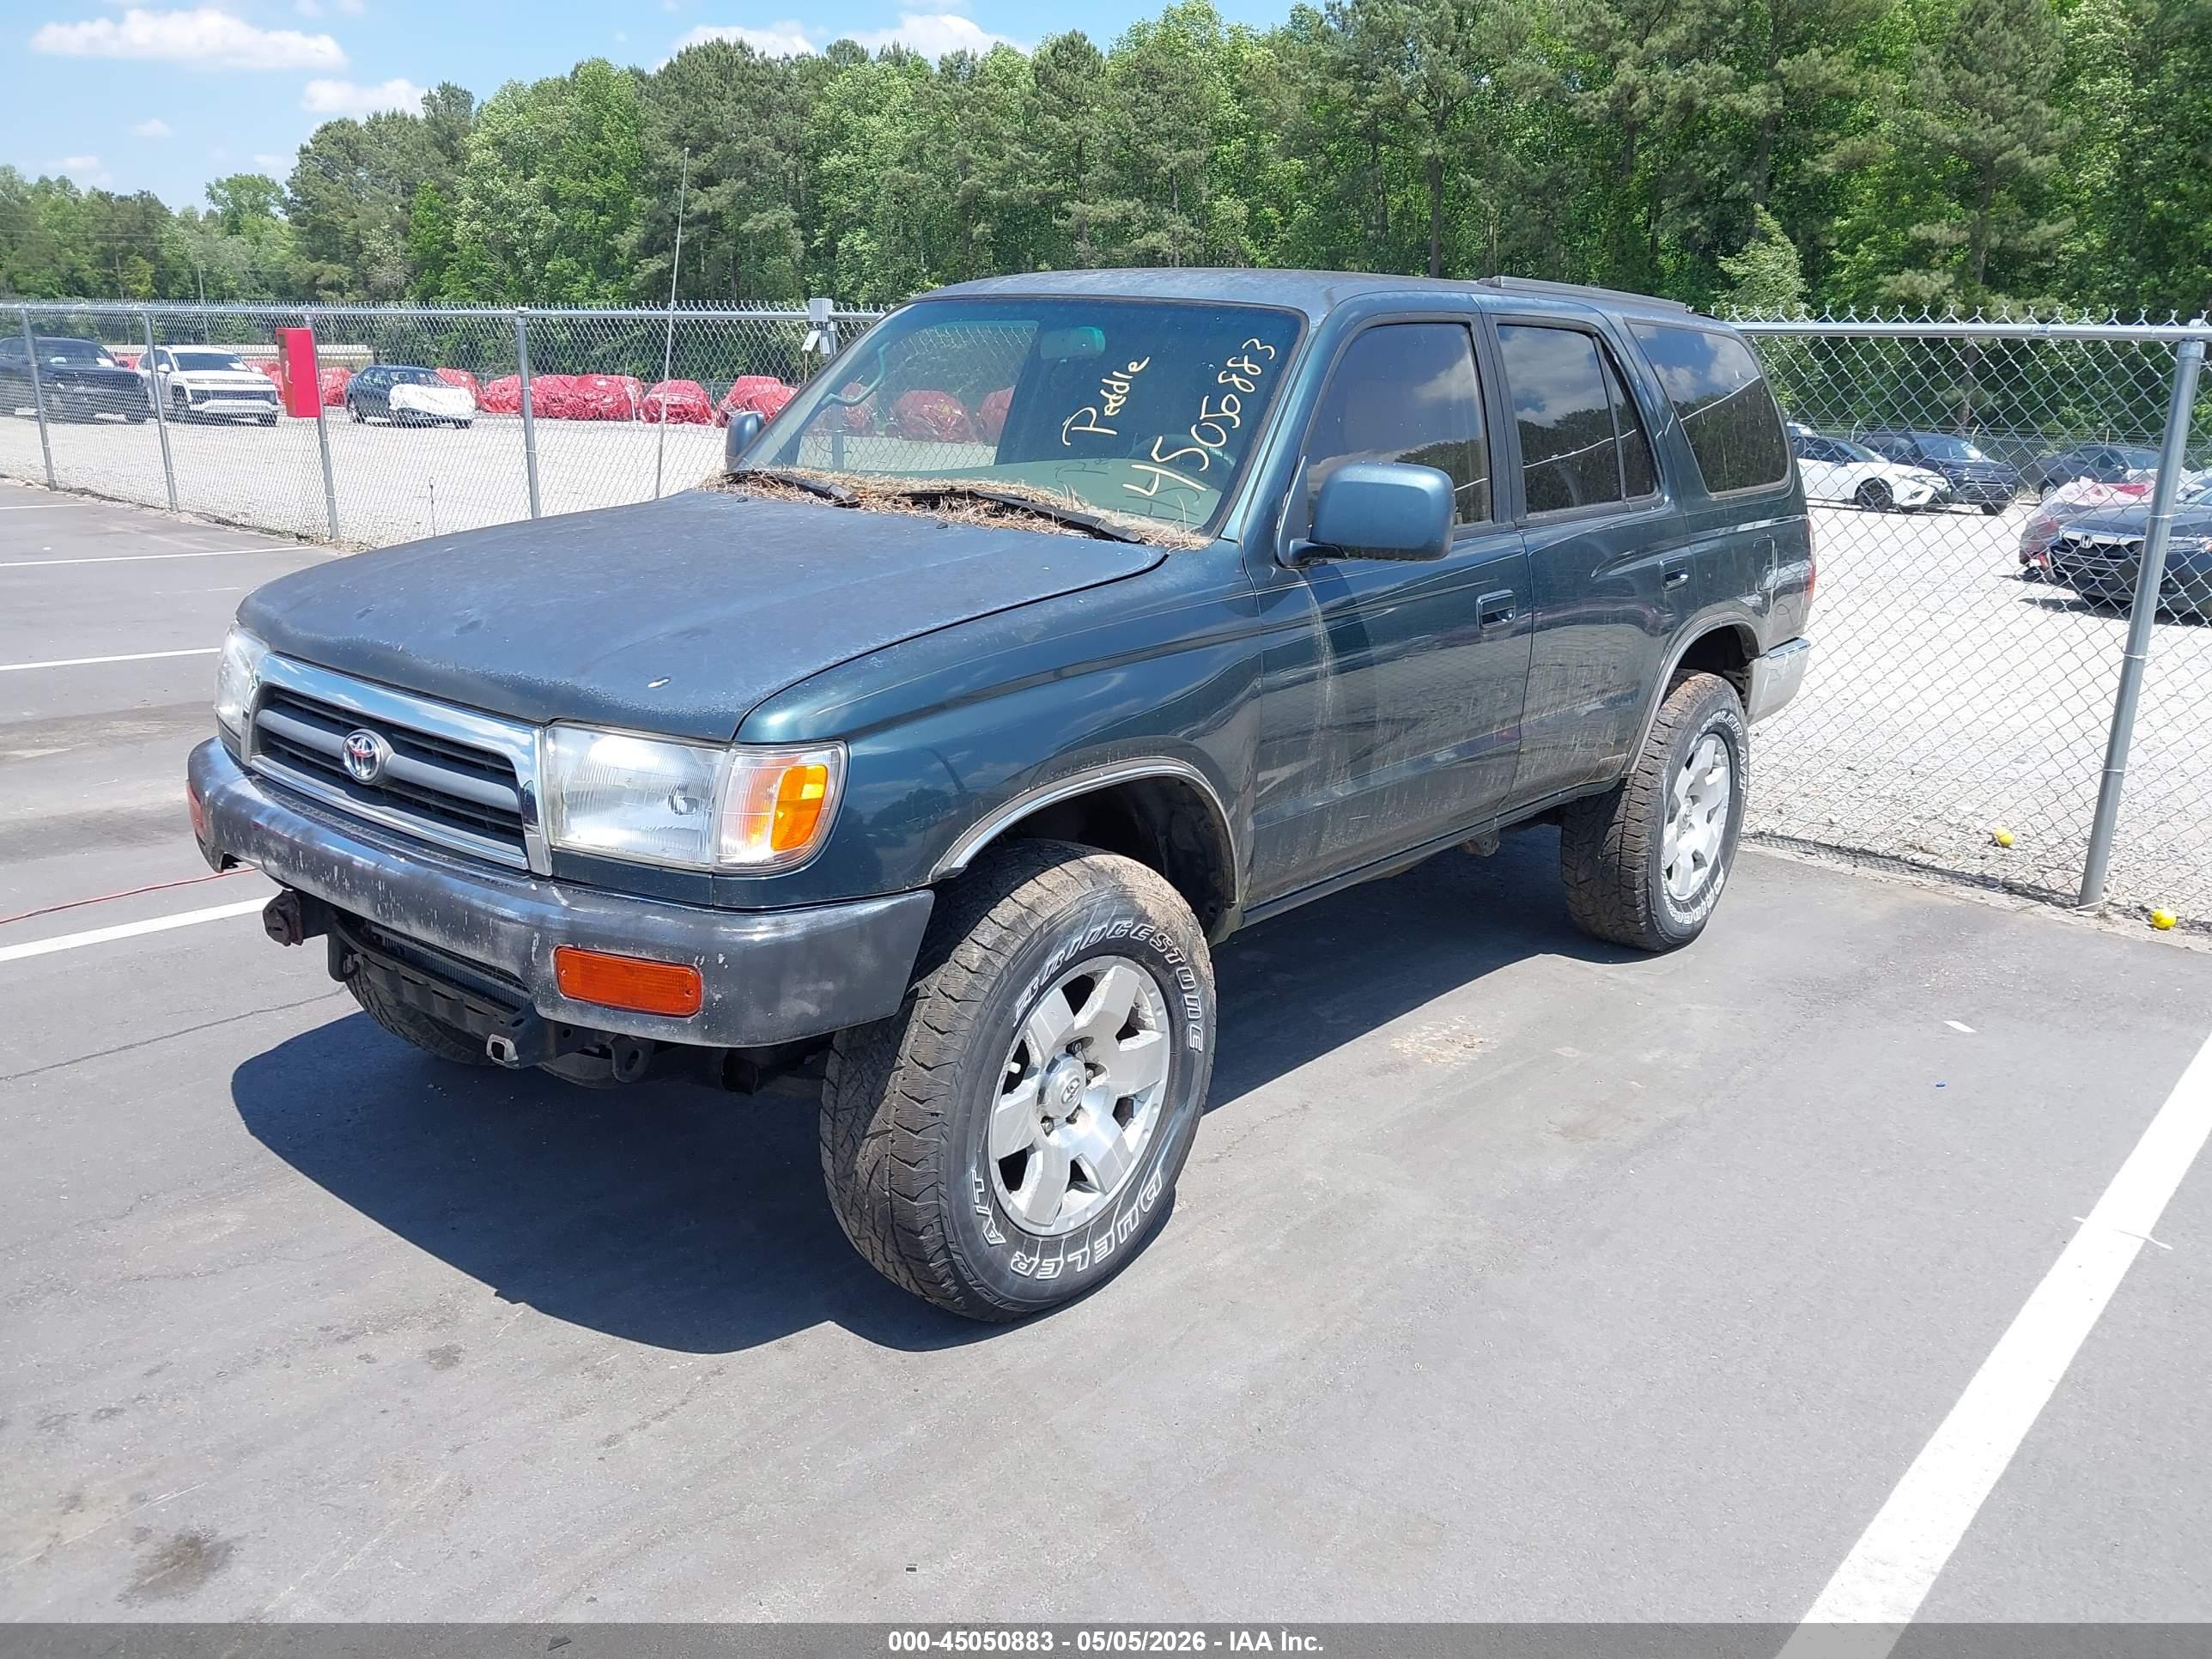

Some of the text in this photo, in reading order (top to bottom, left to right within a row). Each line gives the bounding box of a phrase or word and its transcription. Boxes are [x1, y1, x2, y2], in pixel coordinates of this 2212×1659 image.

[1122, 337, 1276, 496] 45050883
[1662, 850, 1724, 925] BRIDGE
[1013, 919, 1204, 1053] BRIDGESTONE
[1010, 1168, 1163, 1280] DUELER
